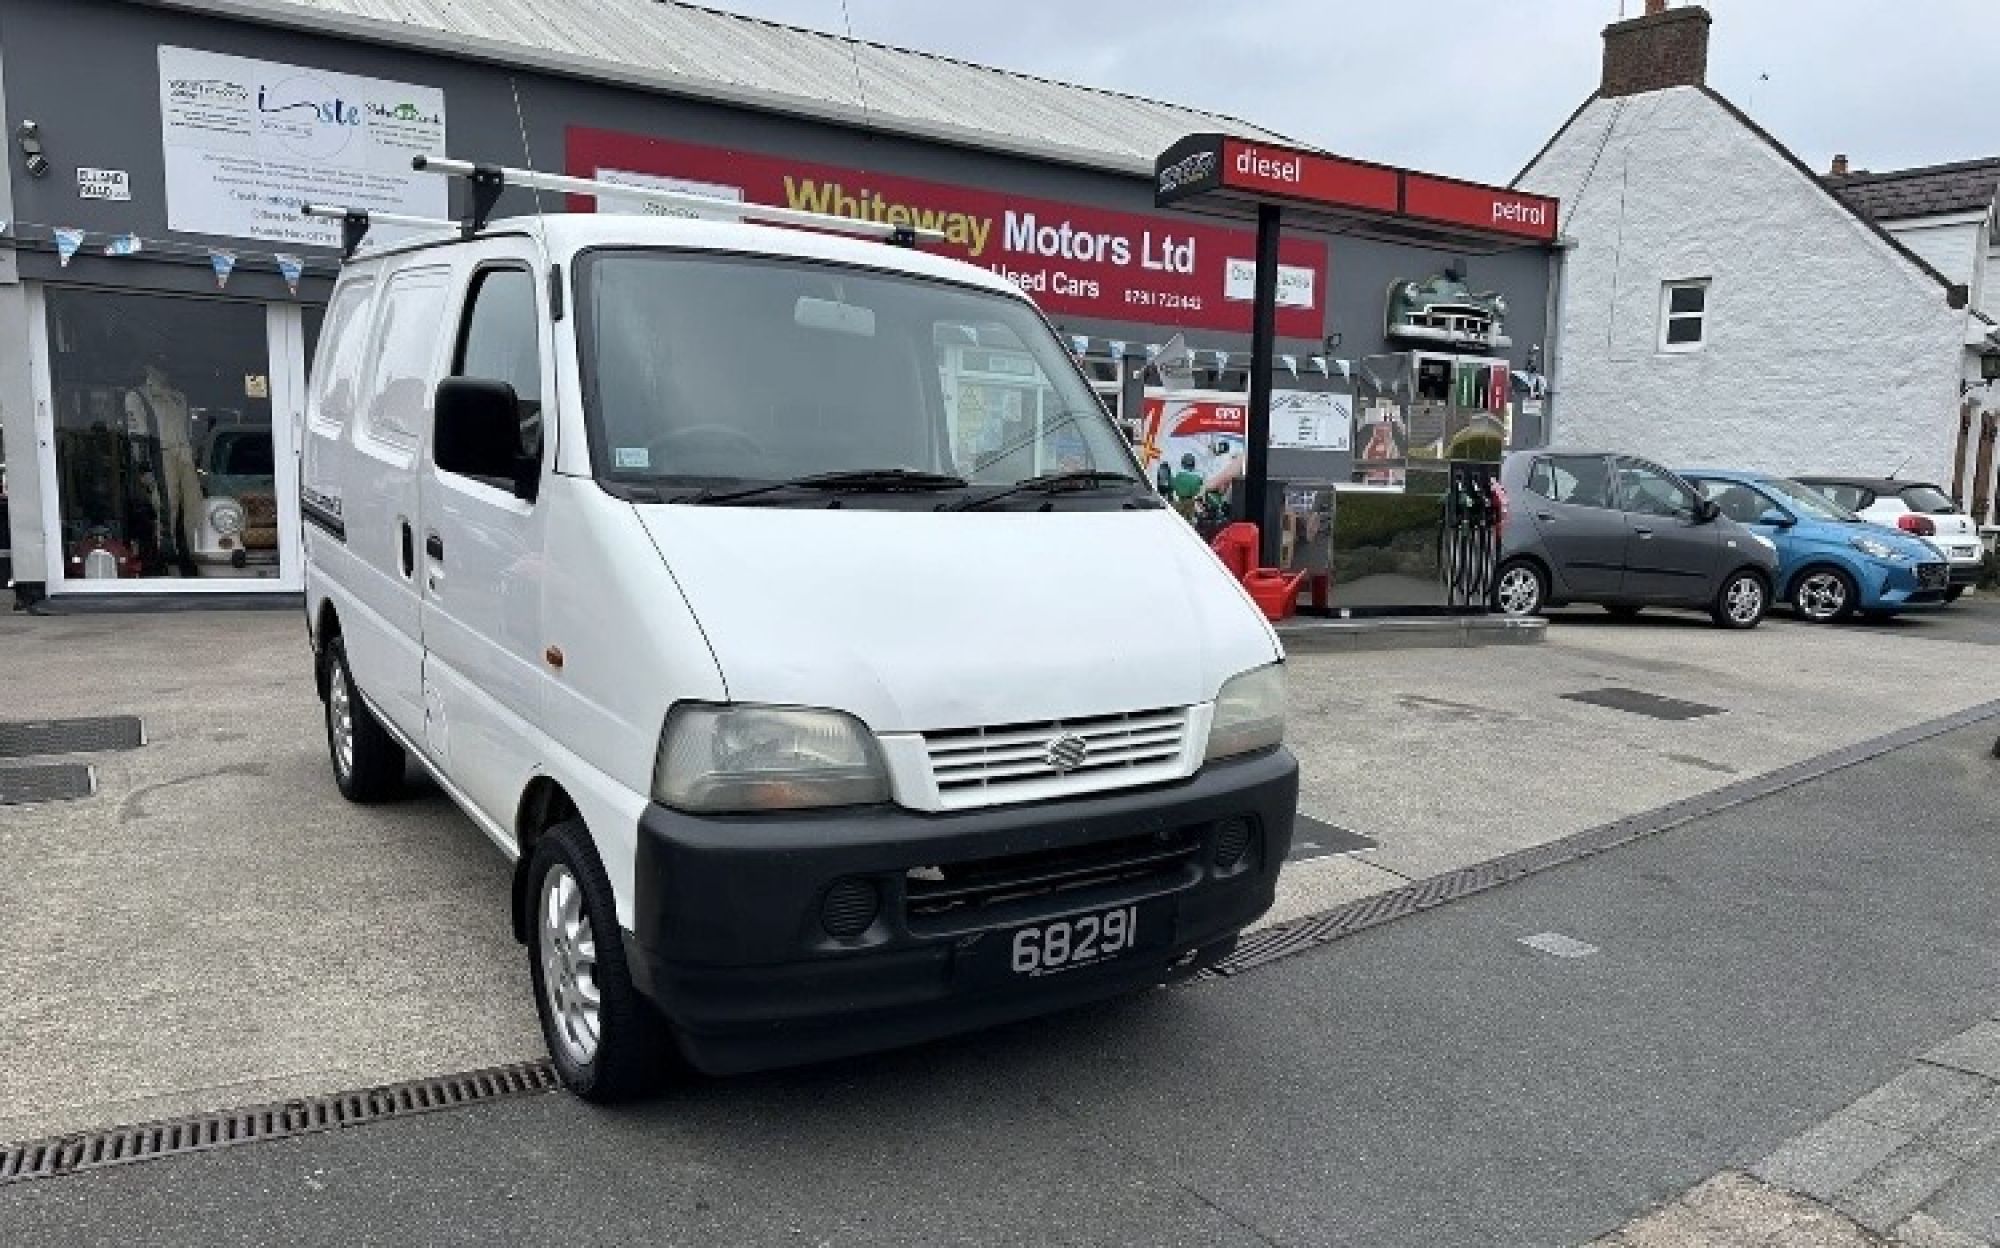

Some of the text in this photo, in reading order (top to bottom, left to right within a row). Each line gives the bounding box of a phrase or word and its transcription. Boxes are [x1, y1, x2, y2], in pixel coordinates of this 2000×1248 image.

[1236, 149, 1300, 182] diesel
[783, 175, 992, 257] Whiteway
[1003, 209, 1132, 266] Motors
[1141, 230, 1197, 273] Ltd
[1492, 200, 1545, 225] petrol
[1052, 271, 1100, 298] Cars
[1012, 905, 1137, 973] 68291
